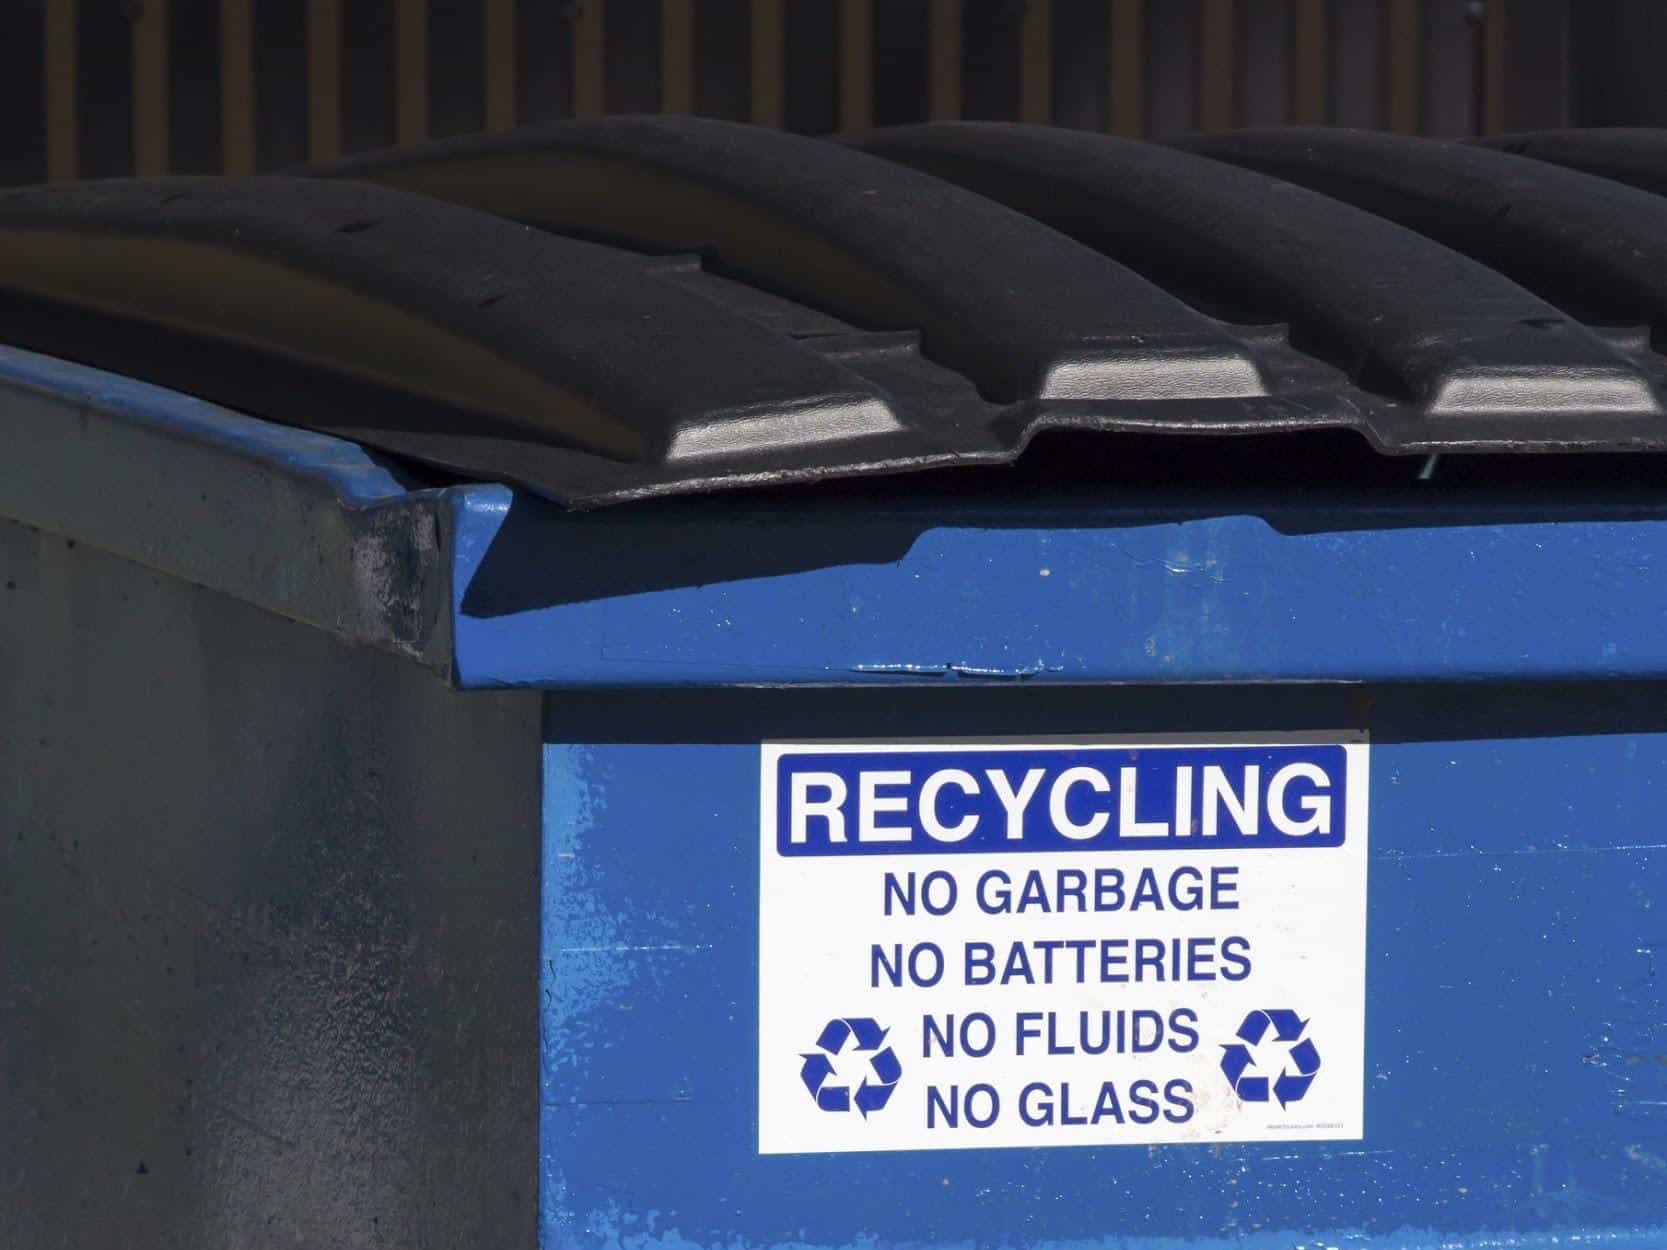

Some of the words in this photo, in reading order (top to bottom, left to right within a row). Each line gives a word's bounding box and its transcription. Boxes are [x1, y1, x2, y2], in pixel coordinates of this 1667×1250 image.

[790, 763, 1331, 843] RECYCLING
[885, 871, 957, 915] NO
[977, 867, 1239, 914] GARBAGE
[872, 943, 944, 987] NO
[965, 937, 1251, 985] BATTERIES
[924, 1013, 995, 1057] NO
[1017, 1008, 1198, 1055] FLUIDS
[928, 1084, 999, 1128] NO
[1019, 1079, 1194, 1126] GLASS
